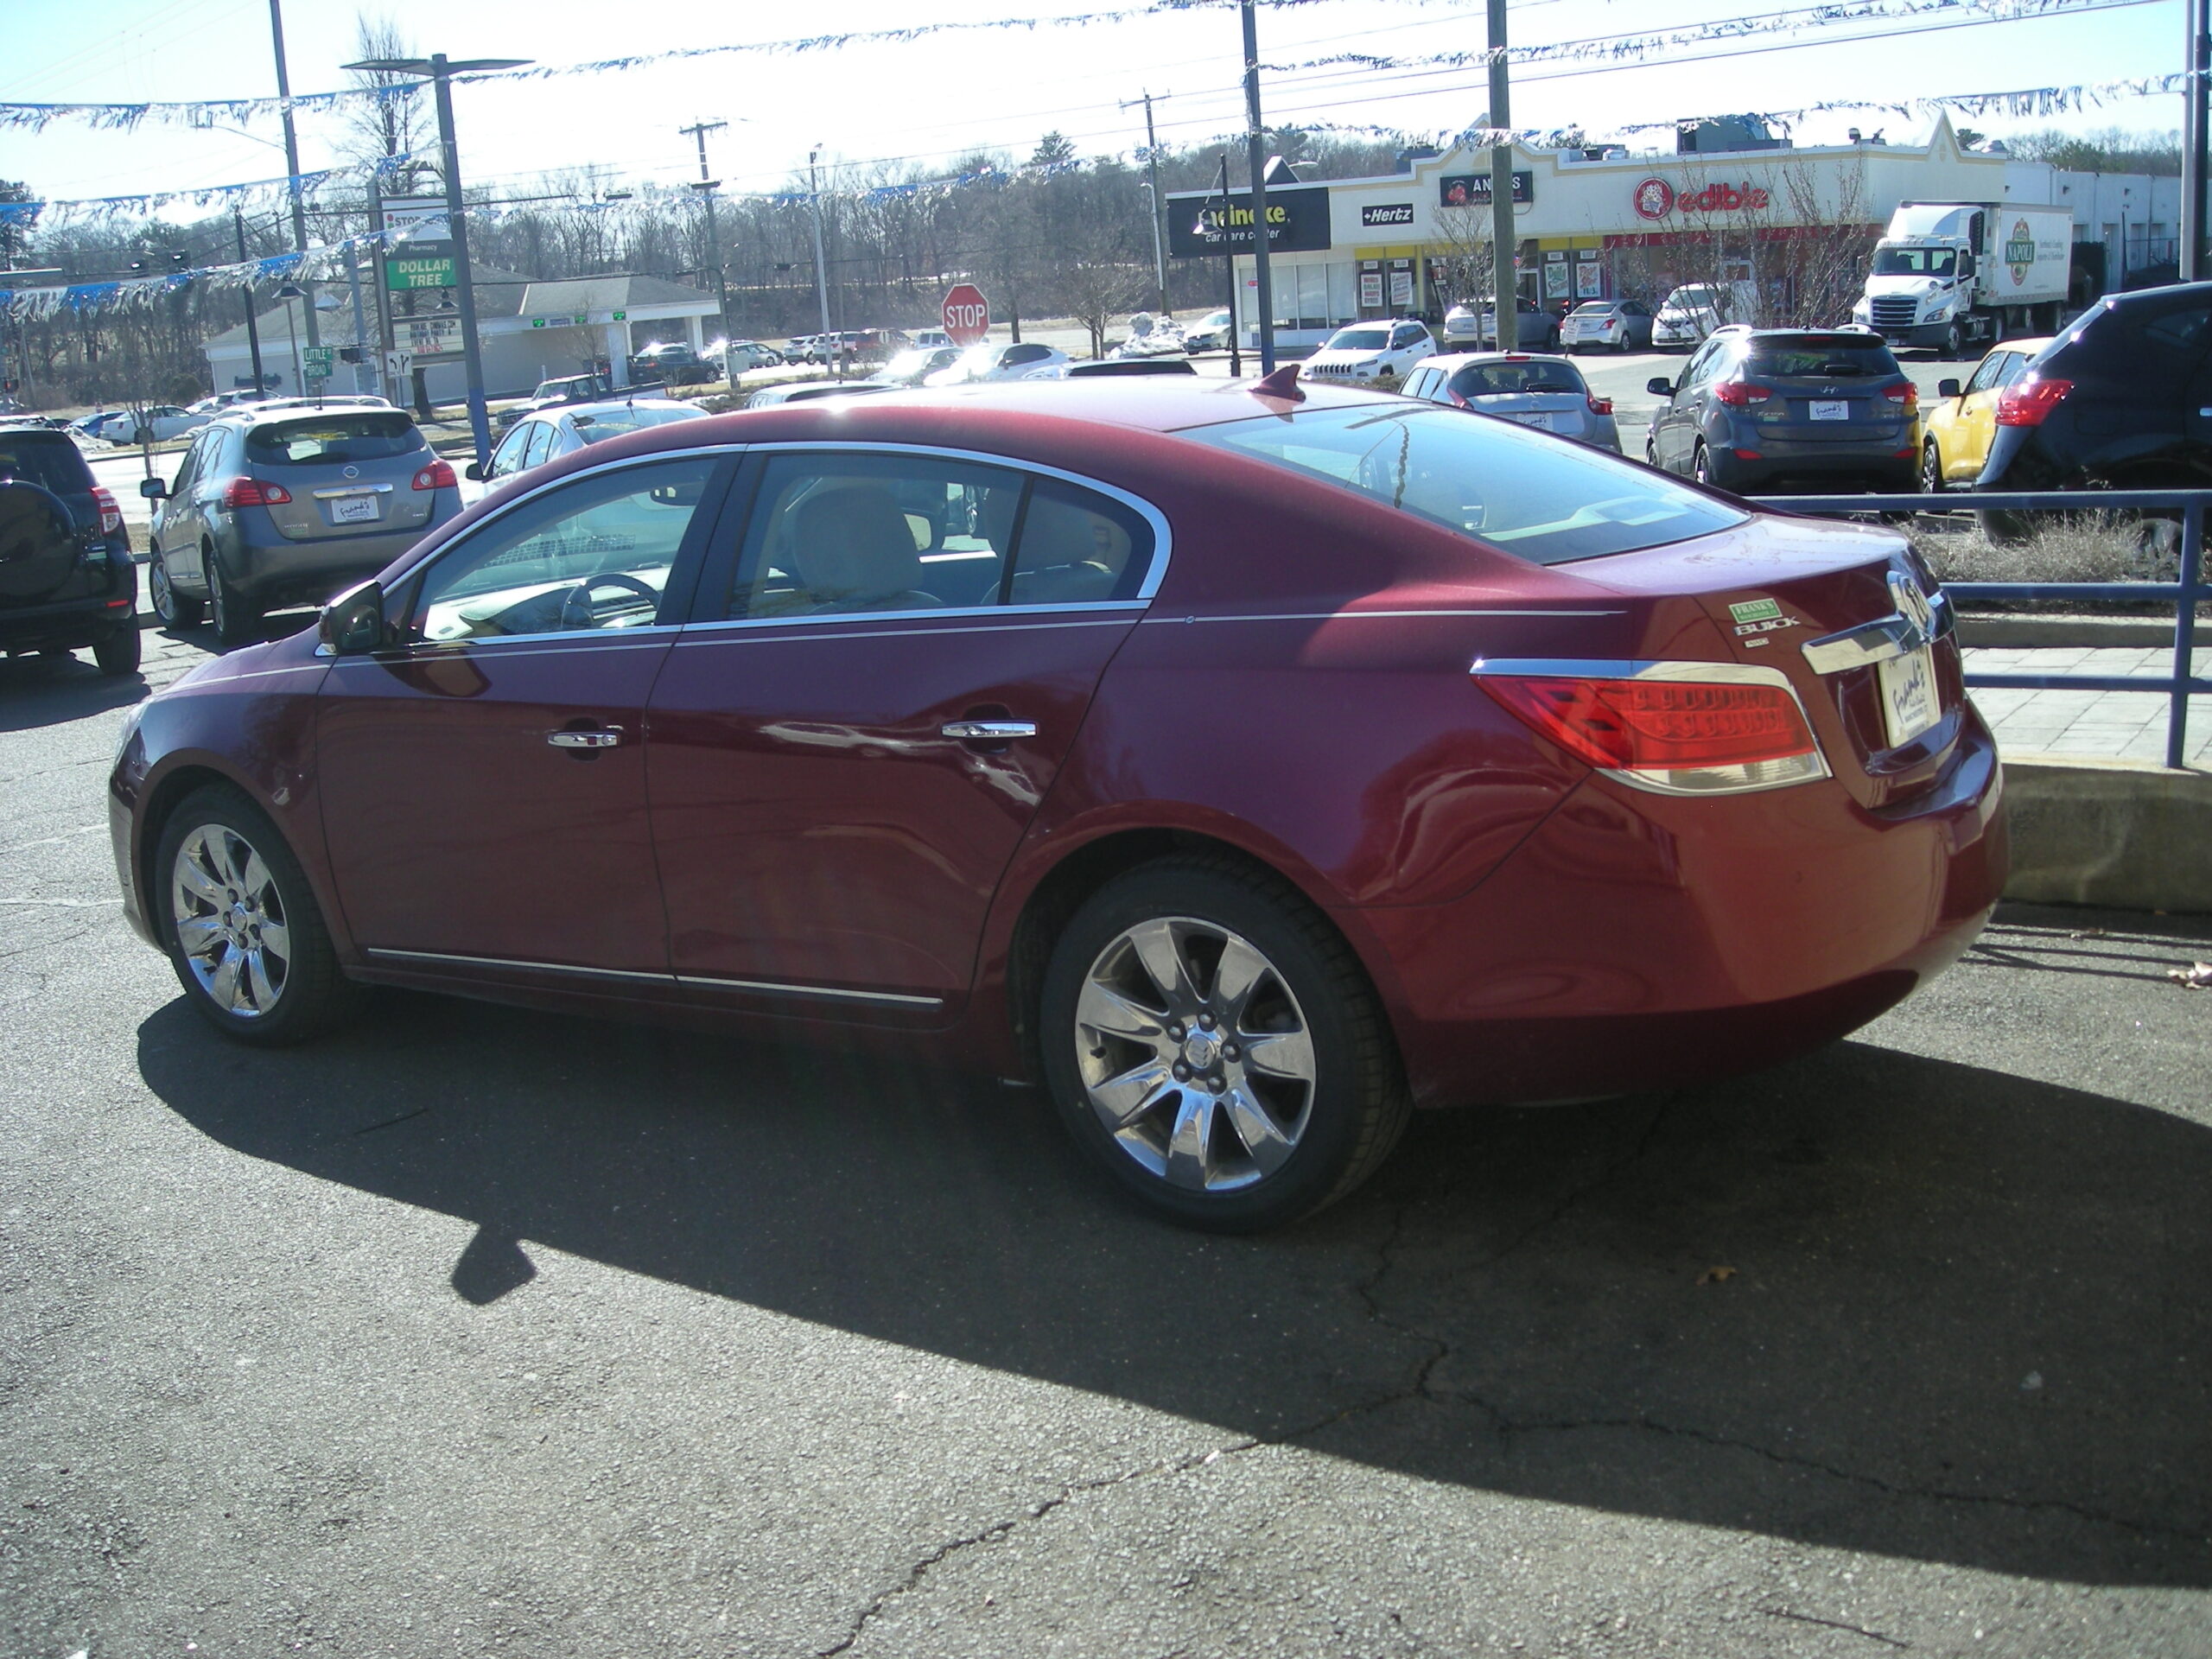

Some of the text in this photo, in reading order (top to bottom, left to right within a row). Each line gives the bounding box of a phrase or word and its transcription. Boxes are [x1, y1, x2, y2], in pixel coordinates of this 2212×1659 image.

[1472, 177, 1521, 192] ANS
[1677, 181, 1769, 213] edible
[1370, 207, 1412, 222] Hertz
[1205, 232, 1222, 242] car
[1224, 231, 1245, 241] are
[2006, 244, 2033, 262] NAPOLI
[398, 258, 450, 273] DOLLAR
[409, 273, 442, 287] TREE
[946, 303, 986, 328] STOP
[305, 347, 326, 360] LITTLE
[307, 364, 327, 377] BROAD
[340, 501, 370, 518] Frank's
[1735, 601, 1775, 614] FRANK'S
[1734, 616, 1801, 636] BUICK
[1893, 658, 1925, 724] Frank's
